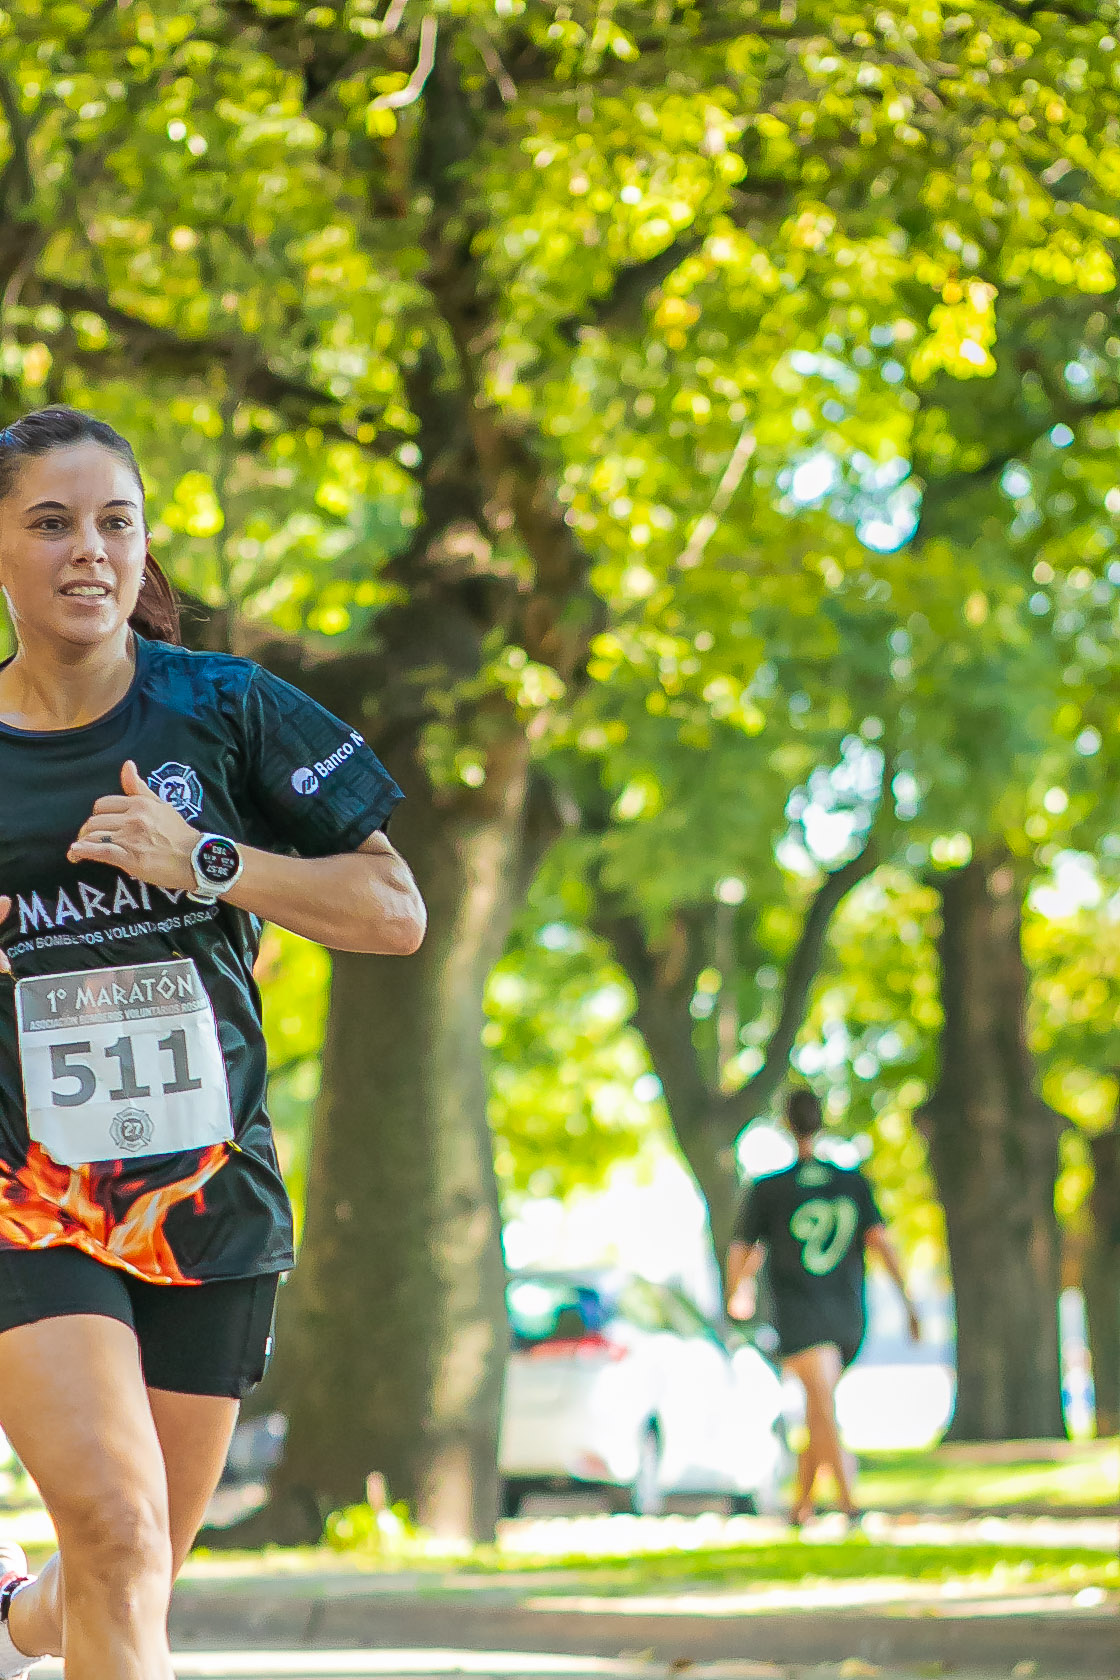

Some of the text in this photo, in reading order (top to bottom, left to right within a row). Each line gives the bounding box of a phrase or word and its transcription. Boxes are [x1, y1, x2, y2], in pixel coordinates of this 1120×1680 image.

[313, 742, 354, 778] Banco
[76, 969, 194, 1009] MARATÓN
[49, 1030, 202, 1107] 511
[122, 1121, 142, 1137] 27
